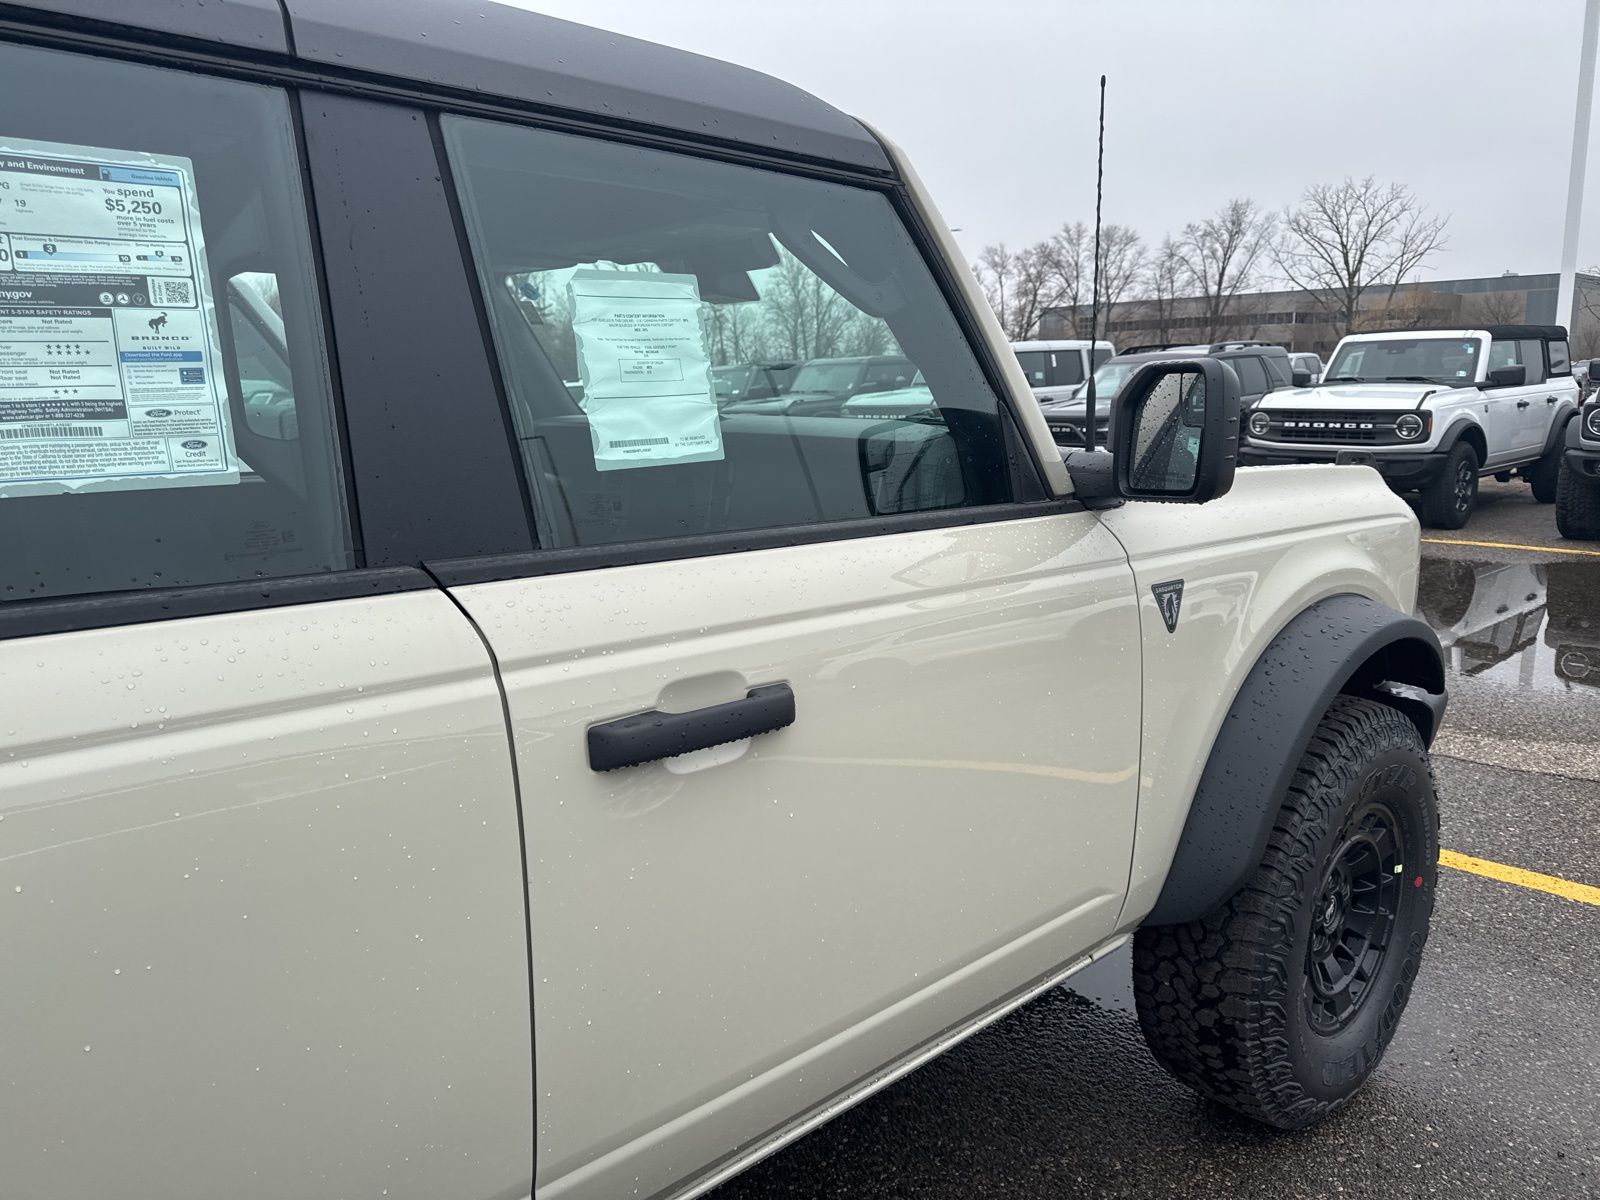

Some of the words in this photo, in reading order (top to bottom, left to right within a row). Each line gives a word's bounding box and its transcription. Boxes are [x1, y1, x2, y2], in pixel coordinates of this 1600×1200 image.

[27, 162, 85, 175] Environment
[116, 188, 154, 198] spend
[105, 198, 162, 214] $5,250
